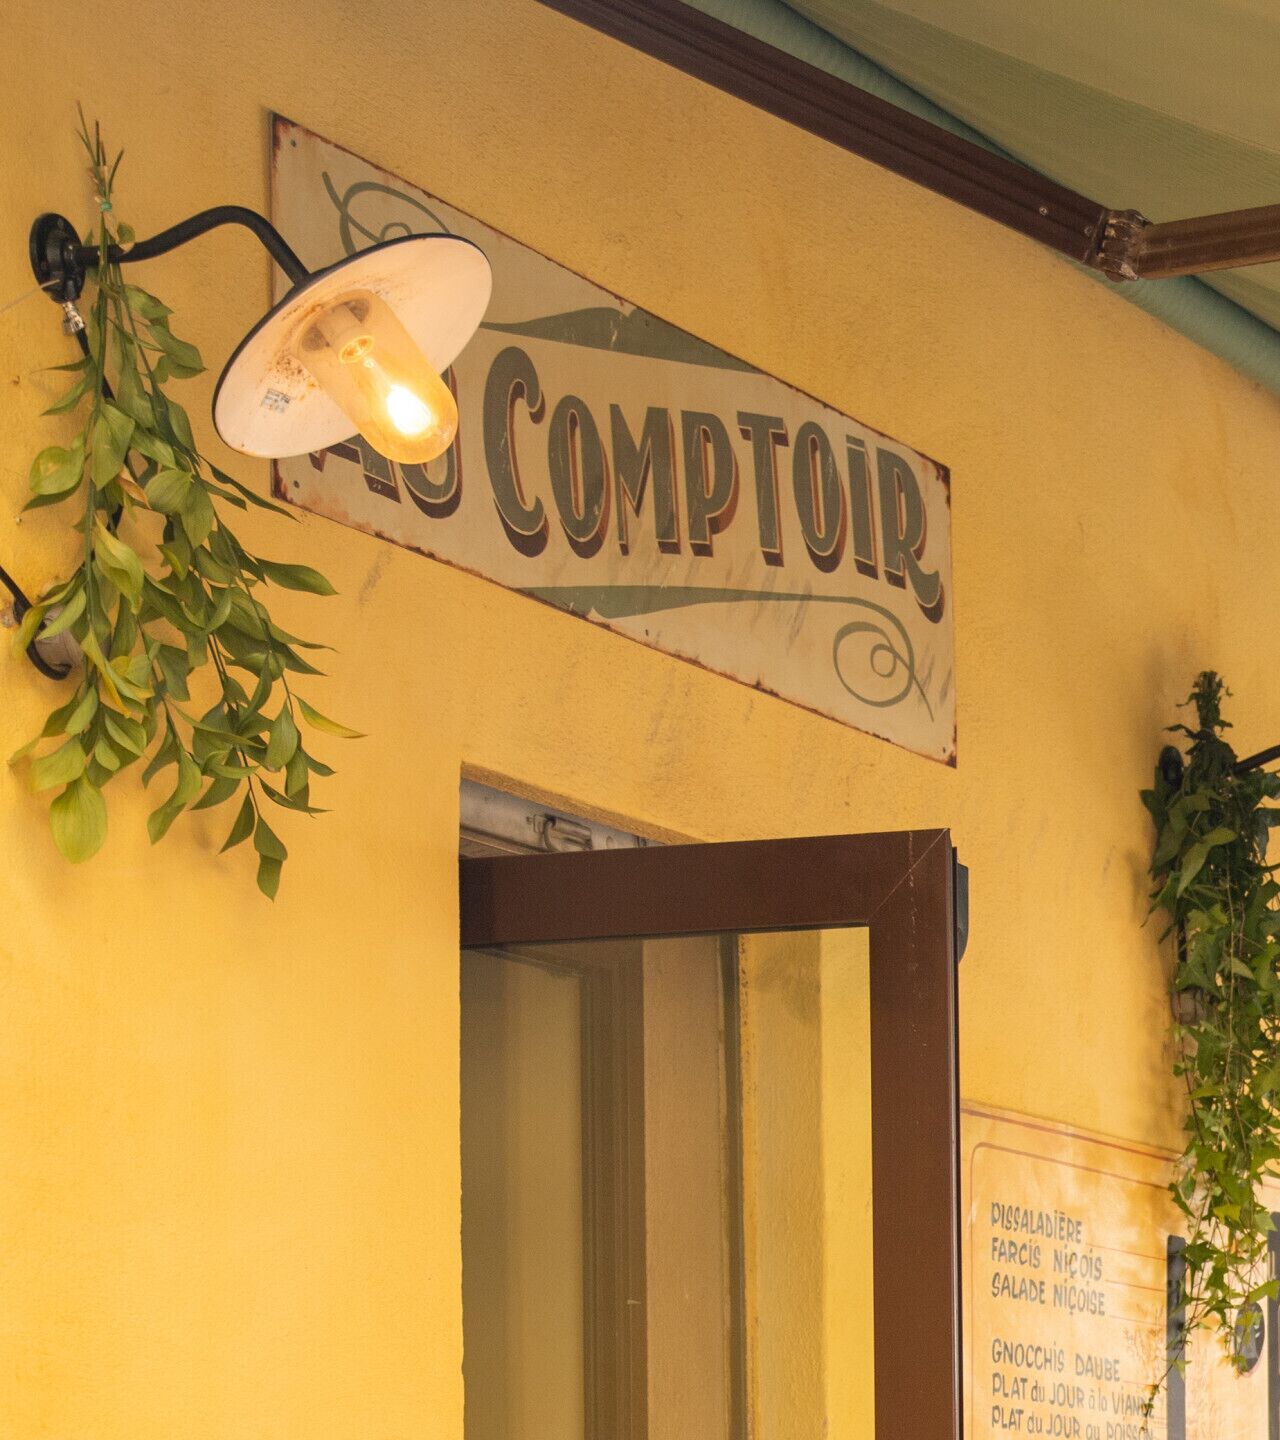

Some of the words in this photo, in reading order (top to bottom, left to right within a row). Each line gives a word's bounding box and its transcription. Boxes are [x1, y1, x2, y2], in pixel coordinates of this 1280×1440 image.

[483, 346, 946, 625] COMPTOIR
[991, 1237, 1041, 1268] FARCIS
[1053, 1244, 1104, 1281] NIÇOIS
[992, 1272, 1046, 1305] SALADE
[1053, 1279, 1106, 1317] NIÇOISE
[992, 1338, 1065, 1373] GNOCCHIS
[1075, 1353, 1121, 1382] DAUBE
[992, 1372, 1028, 1401] PLAT
[1031, 1380, 1046, 1403] du
[1049, 1382, 1085, 1410] JOUR
[1098, 1386, 1108, 1412] la
[992, 1405, 1025, 1431] PLAT
[1026, 1412, 1043, 1434] du
[1046, 1413, 1081, 1440] JOUR
